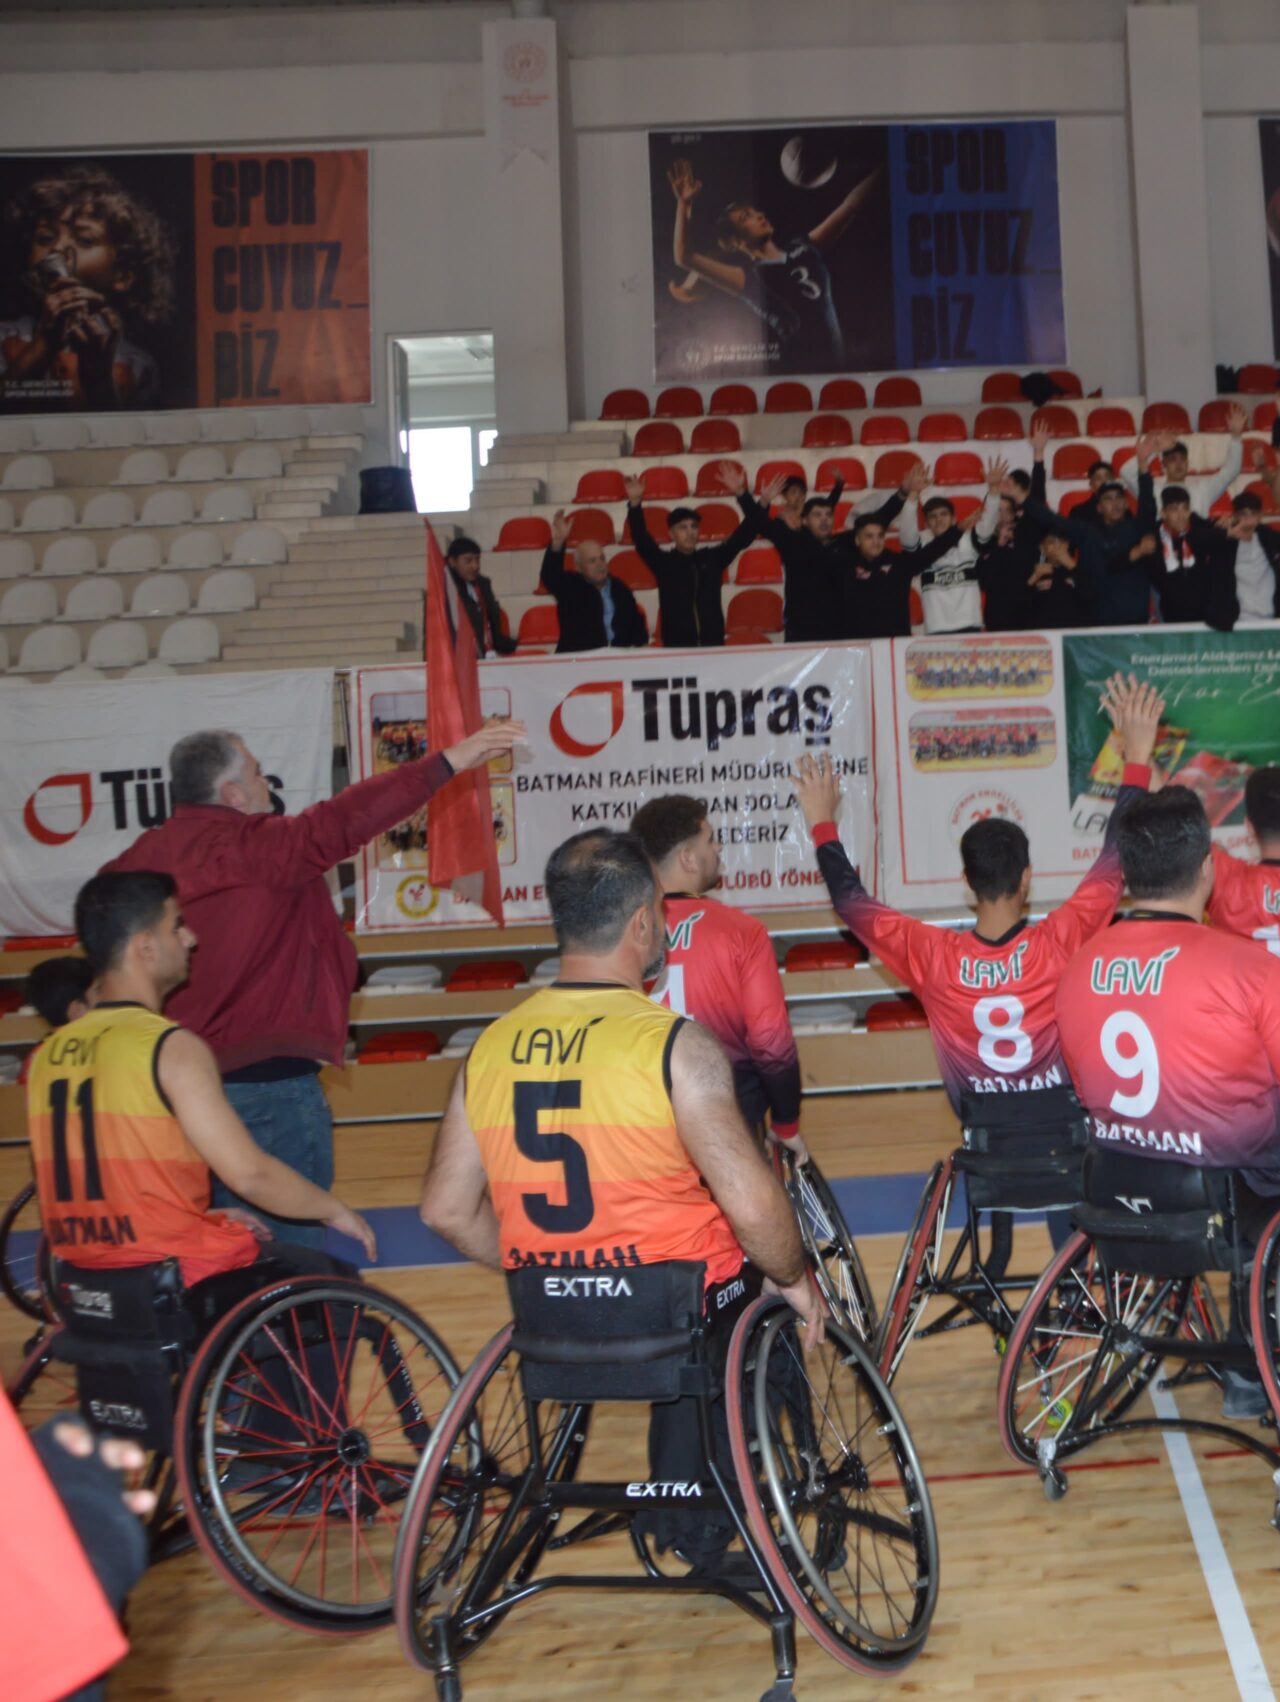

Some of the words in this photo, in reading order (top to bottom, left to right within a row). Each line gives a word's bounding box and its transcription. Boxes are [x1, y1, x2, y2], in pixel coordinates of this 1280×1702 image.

[211, 156, 317, 228] SPOR
[904, 128, 1008, 196] SPOR
[213, 323, 280, 400] BİZ
[911, 287, 976, 364] BİZ
[631, 677, 834, 752] Tüpraş
[516, 772, 603, 793] BATMAN
[609, 760, 705, 788] RAFİNERİ
[973, 994, 1033, 1073] 8
[1100, 1010, 1160, 1119] 9
[48, 1076, 105, 1203] 11
[513, 1079, 595, 1234] 5
[543, 1275, 634, 1298] EXTRA
[716, 1279, 746, 1311] EXTRA
[625, 1480, 703, 1499] EXTRA
